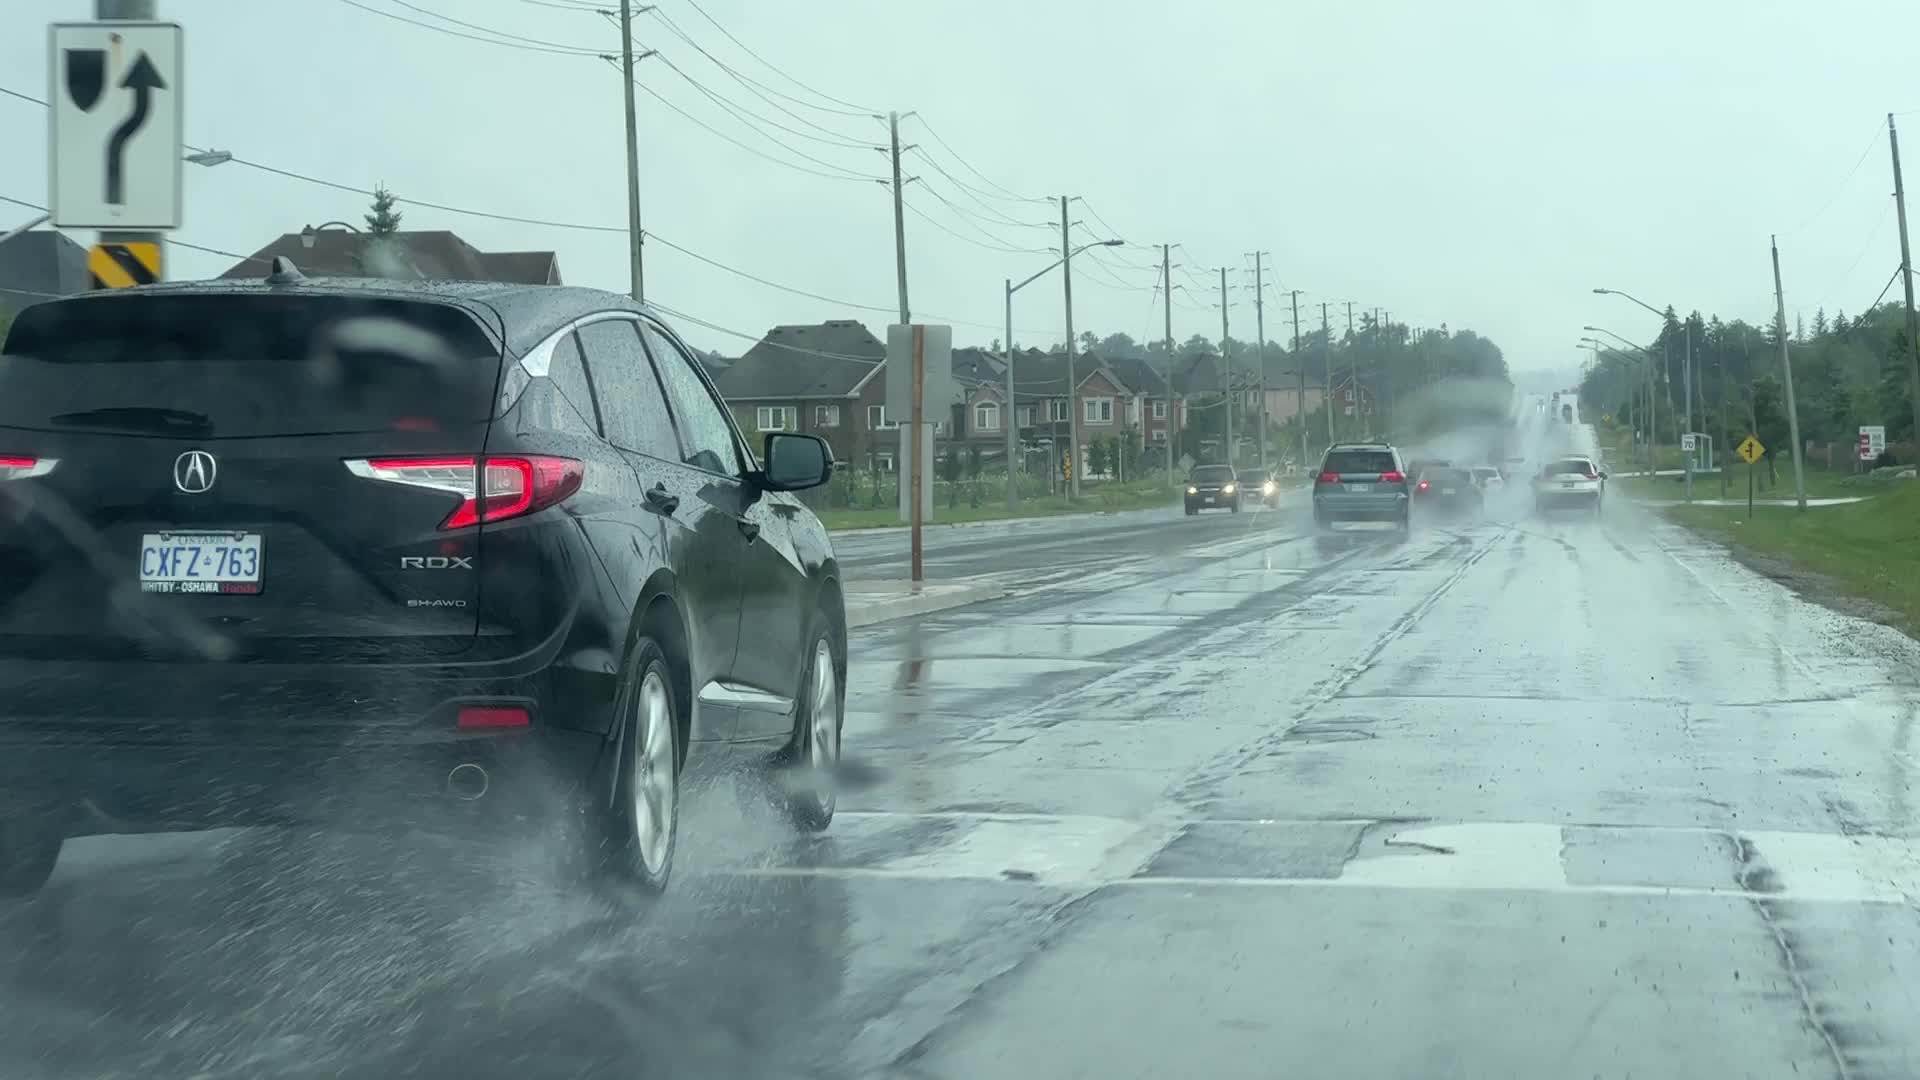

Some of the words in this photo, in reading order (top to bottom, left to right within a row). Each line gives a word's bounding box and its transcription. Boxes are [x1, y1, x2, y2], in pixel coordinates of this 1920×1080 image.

[142, 547, 201, 577] CXFZ
[215, 547, 257, 576] 763
[401, 556, 473, 569] RDX
